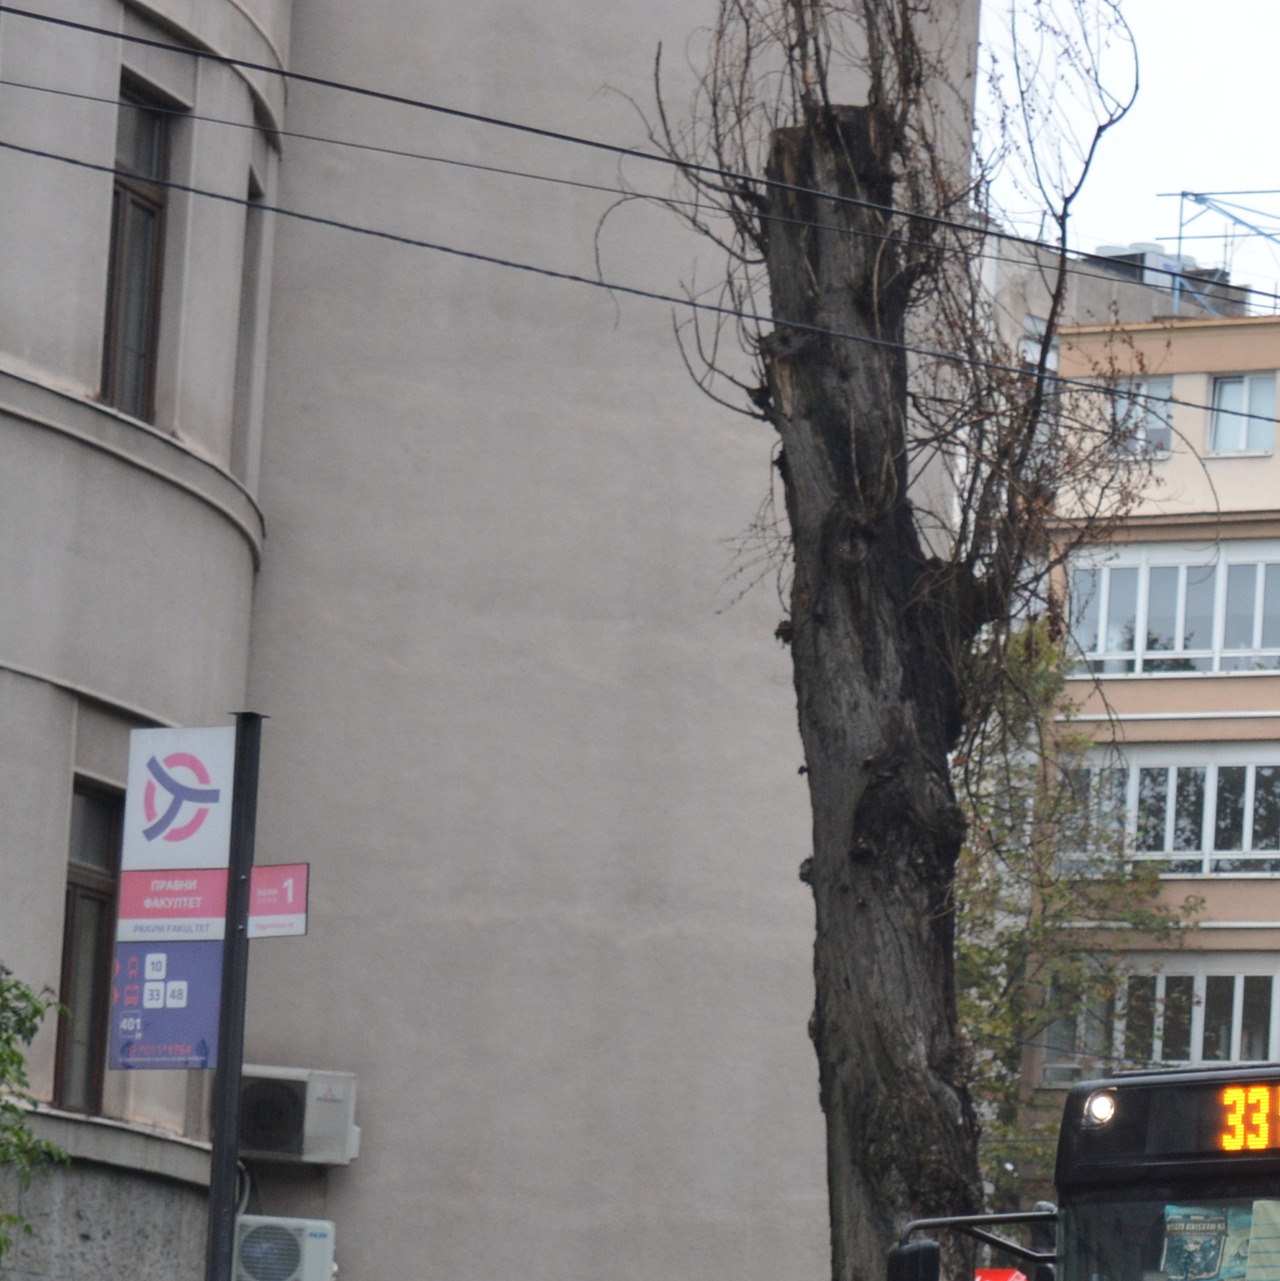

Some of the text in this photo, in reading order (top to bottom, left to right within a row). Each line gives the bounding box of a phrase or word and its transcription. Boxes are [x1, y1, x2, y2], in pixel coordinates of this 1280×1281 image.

[151, 879, 198, 891] ПРАВНИ
[282, 878, 295, 904] 1
[143, 896, 203, 909] ФАКУЛТЕТ
[133, 923, 210, 934] PRAVNI FAKULTET
[150, 960, 163, 972] 10
[149, 988, 184, 1001] 33 48
[120, 1018, 142, 1031] 401
[1222, 1087, 1270, 1150] 33
